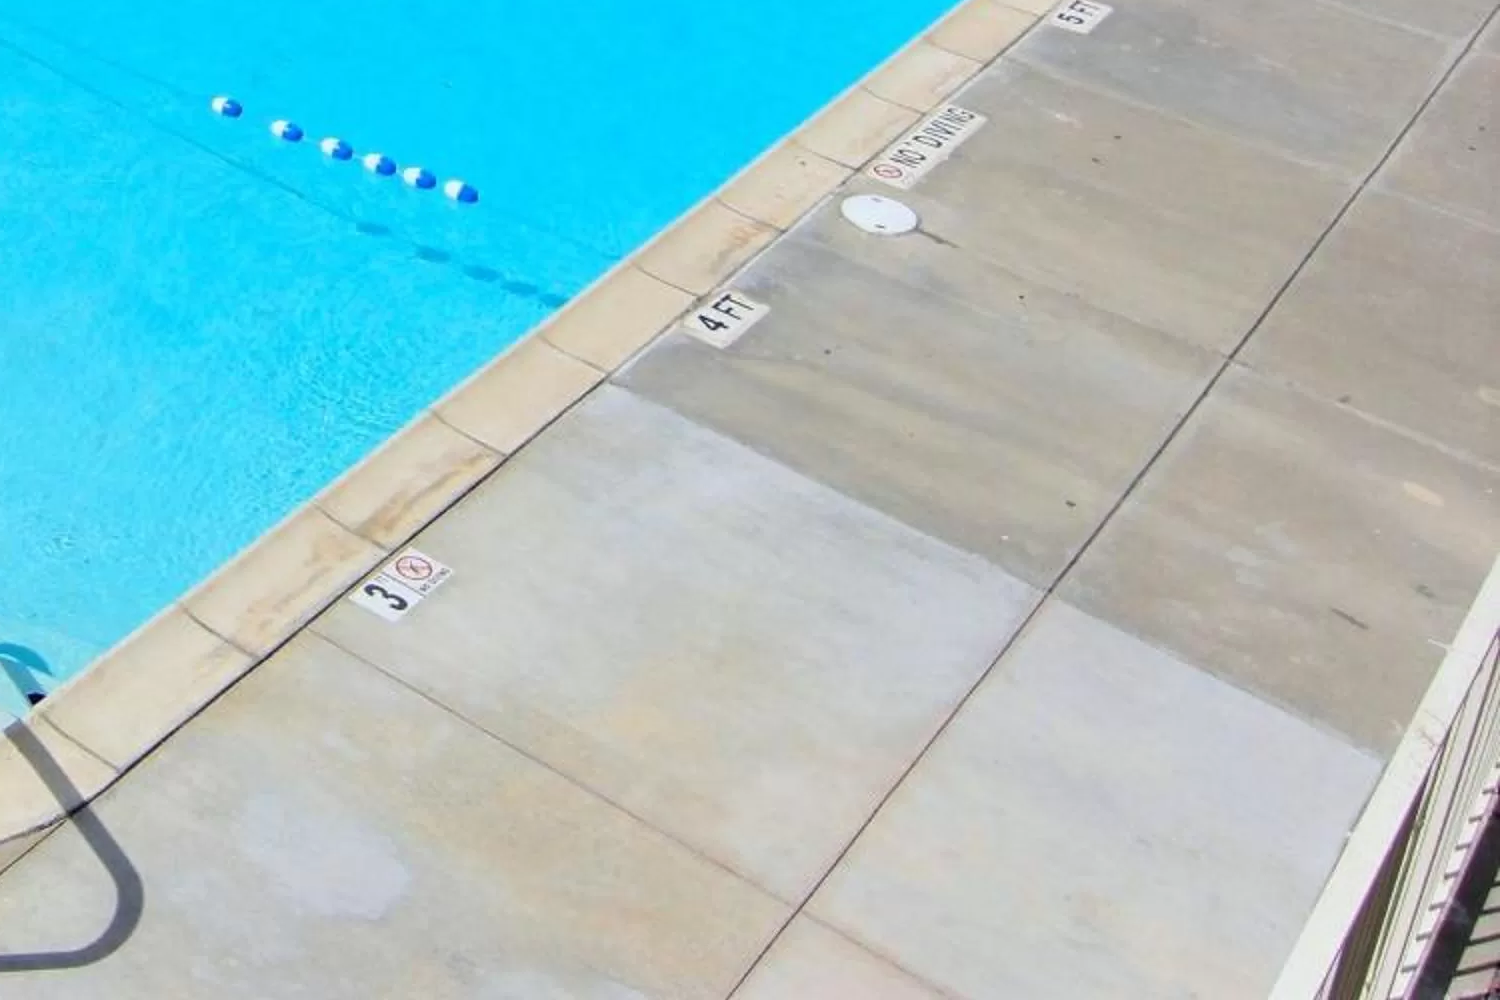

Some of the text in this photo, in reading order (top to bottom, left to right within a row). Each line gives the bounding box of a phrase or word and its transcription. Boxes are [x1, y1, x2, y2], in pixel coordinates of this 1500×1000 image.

[1056, 0, 1102, 25] 5 FT
[888, 106, 977, 170] NO DIVING
[697, 292, 756, 332] 4 FT
[363, 583, 409, 612] 3
